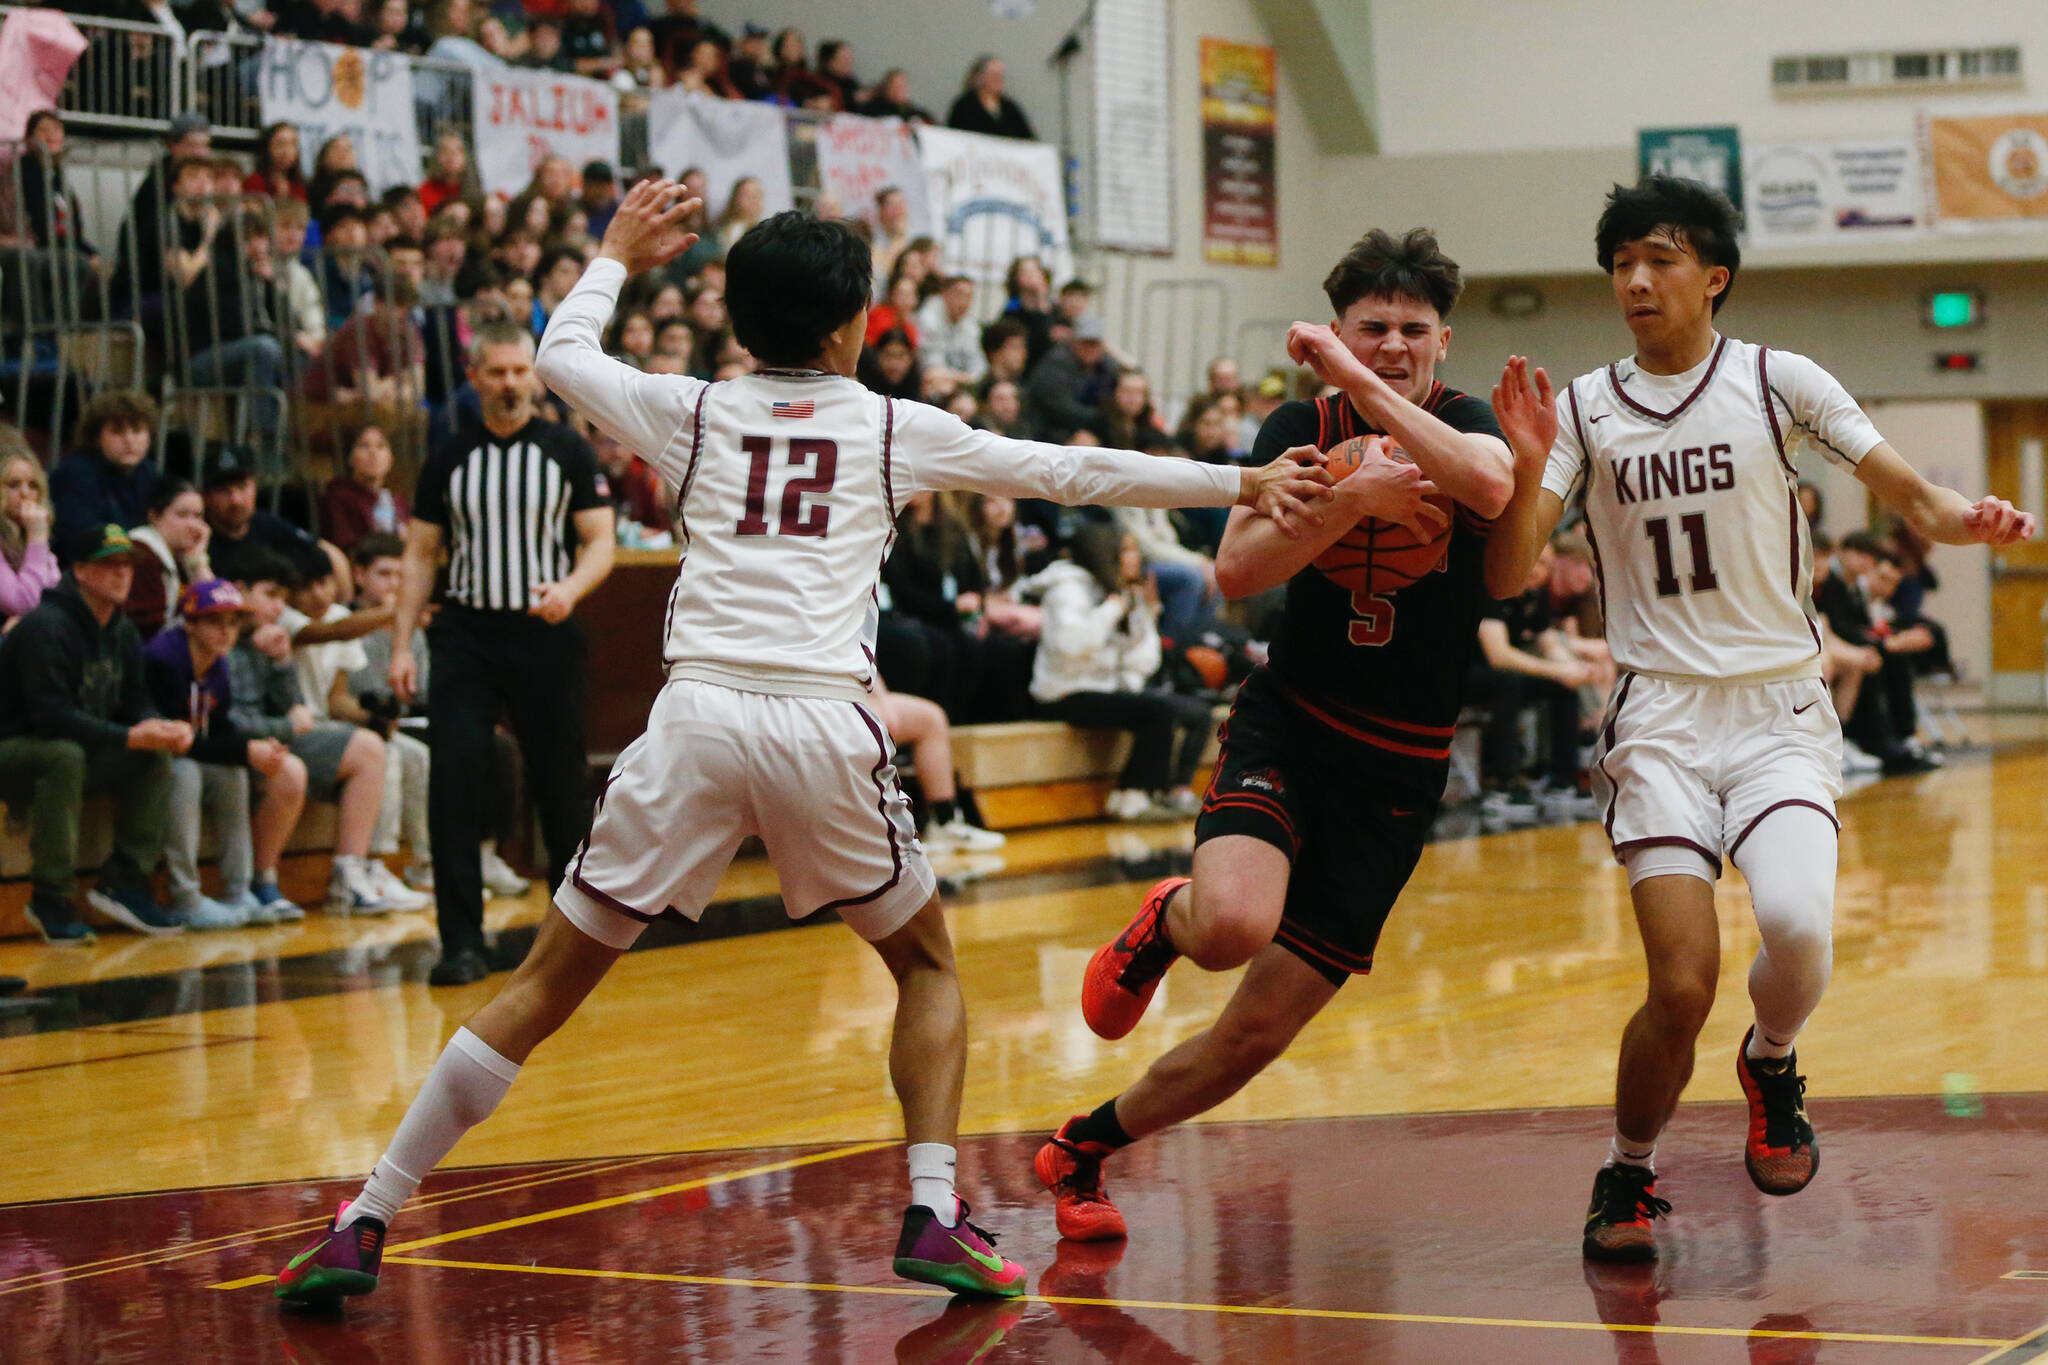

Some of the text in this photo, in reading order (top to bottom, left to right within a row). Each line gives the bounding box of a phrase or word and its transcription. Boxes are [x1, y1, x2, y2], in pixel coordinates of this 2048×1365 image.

[735, 433, 839, 538] 12
[1611, 443, 1735, 505] KINGS
[1643, 511, 1720, 599] 11
[1348, 590, 1396, 647] 5
